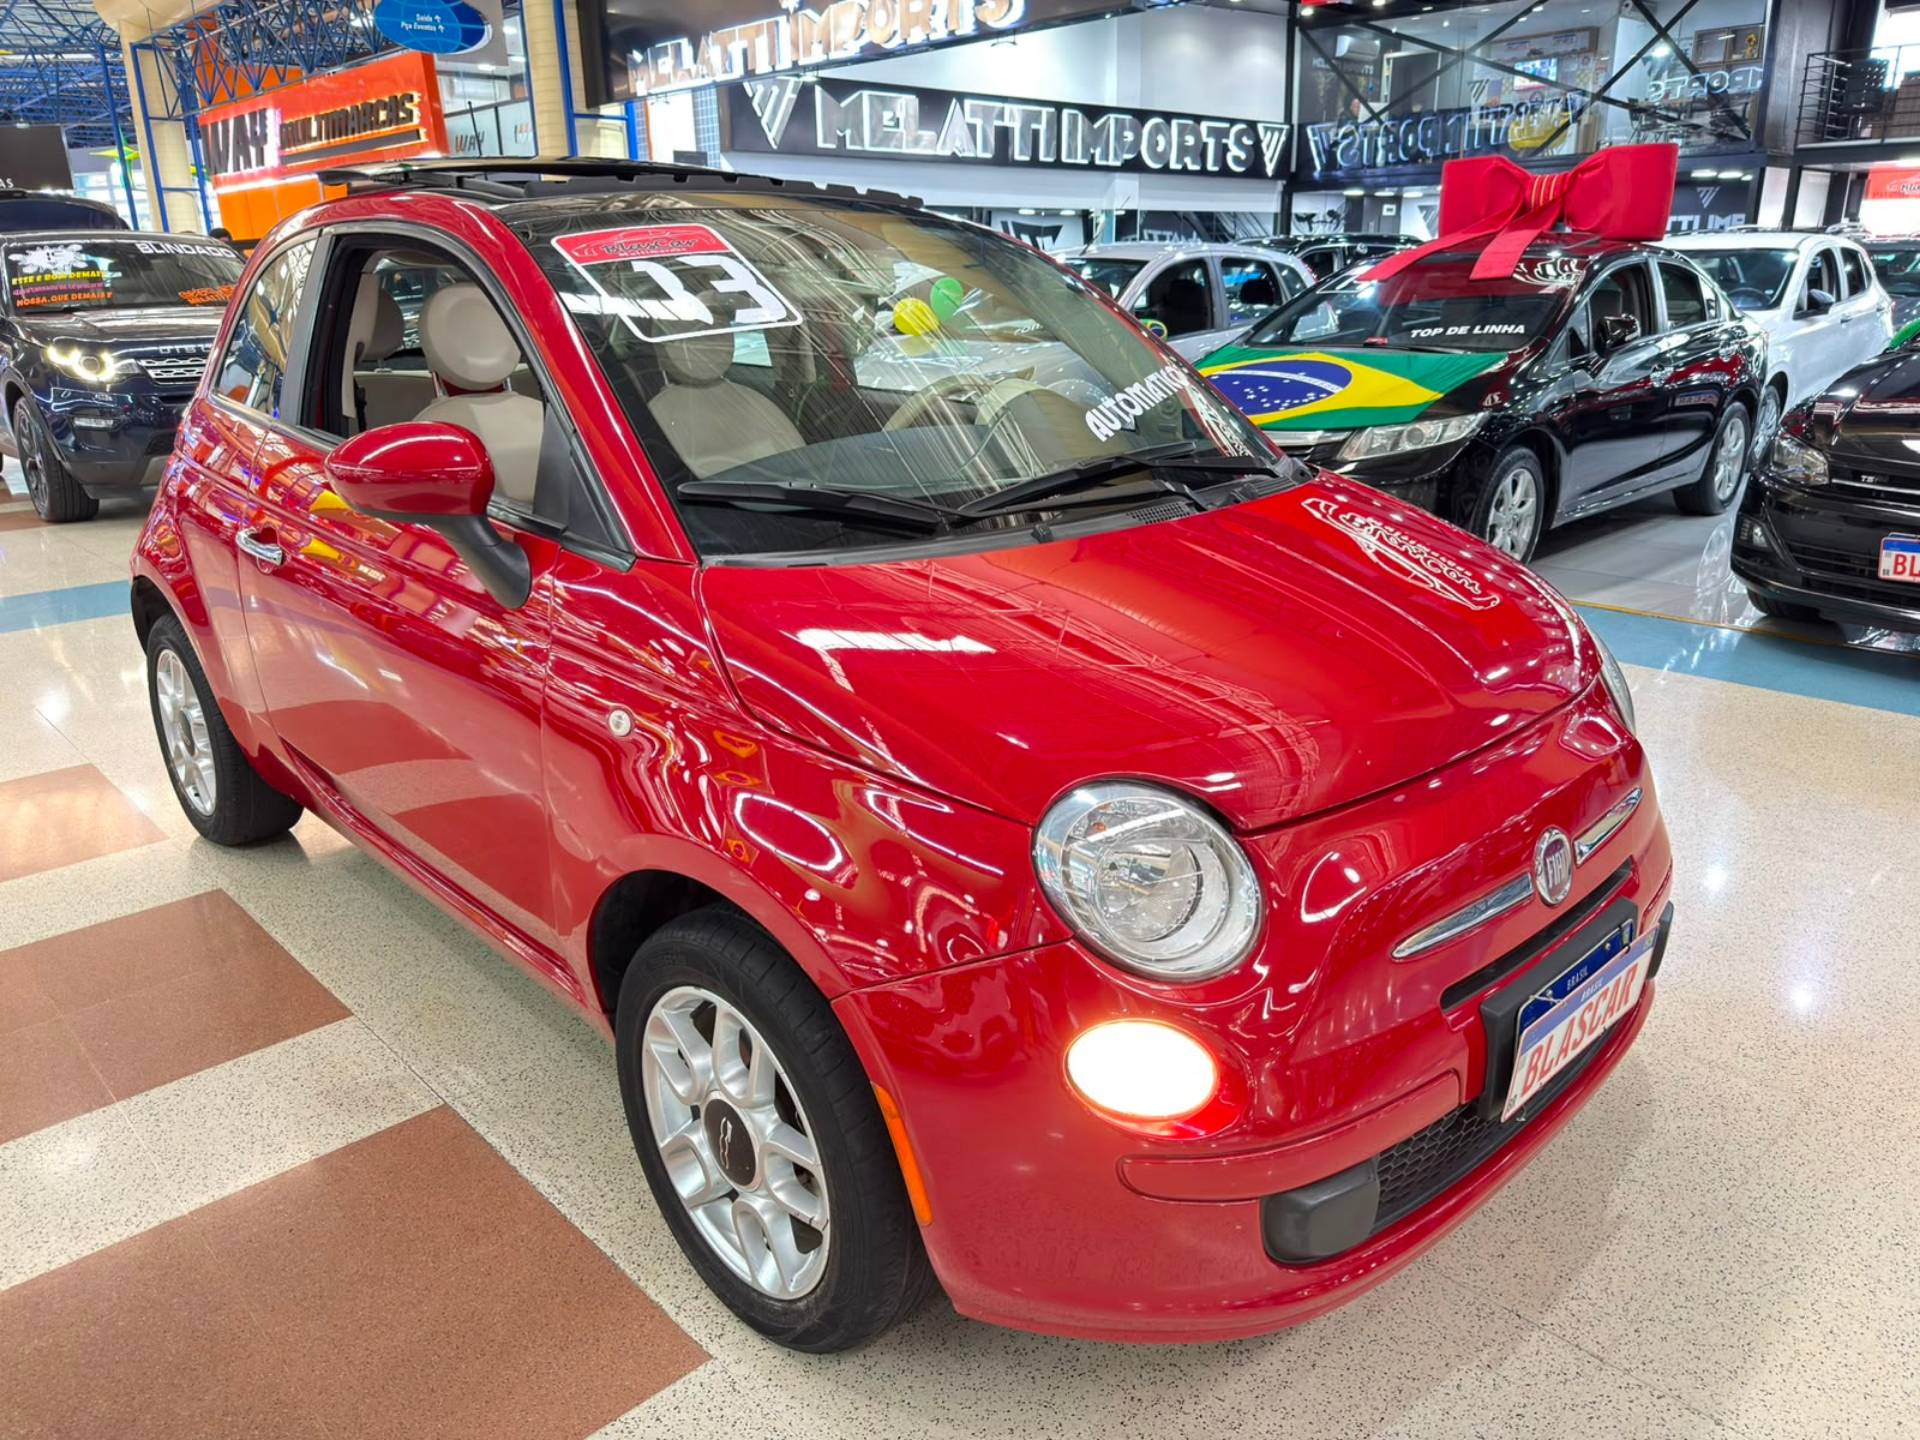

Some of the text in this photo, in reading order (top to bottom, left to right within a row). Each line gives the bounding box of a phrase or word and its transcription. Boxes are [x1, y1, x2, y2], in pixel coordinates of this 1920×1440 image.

[201, 93, 415, 177] WAY MULTIMARCAS
[815, 84, 1256, 173] MELATTI IMPORTS
[135, 241, 237, 258] BLINDADO
[1411, 324, 1525, 338] TOP DE LINHA
[1546, 848, 1569, 888] FIAT
[1567, 966, 1588, 991] BRASIL
[1521, 963, 1639, 1097] BLASCAR
